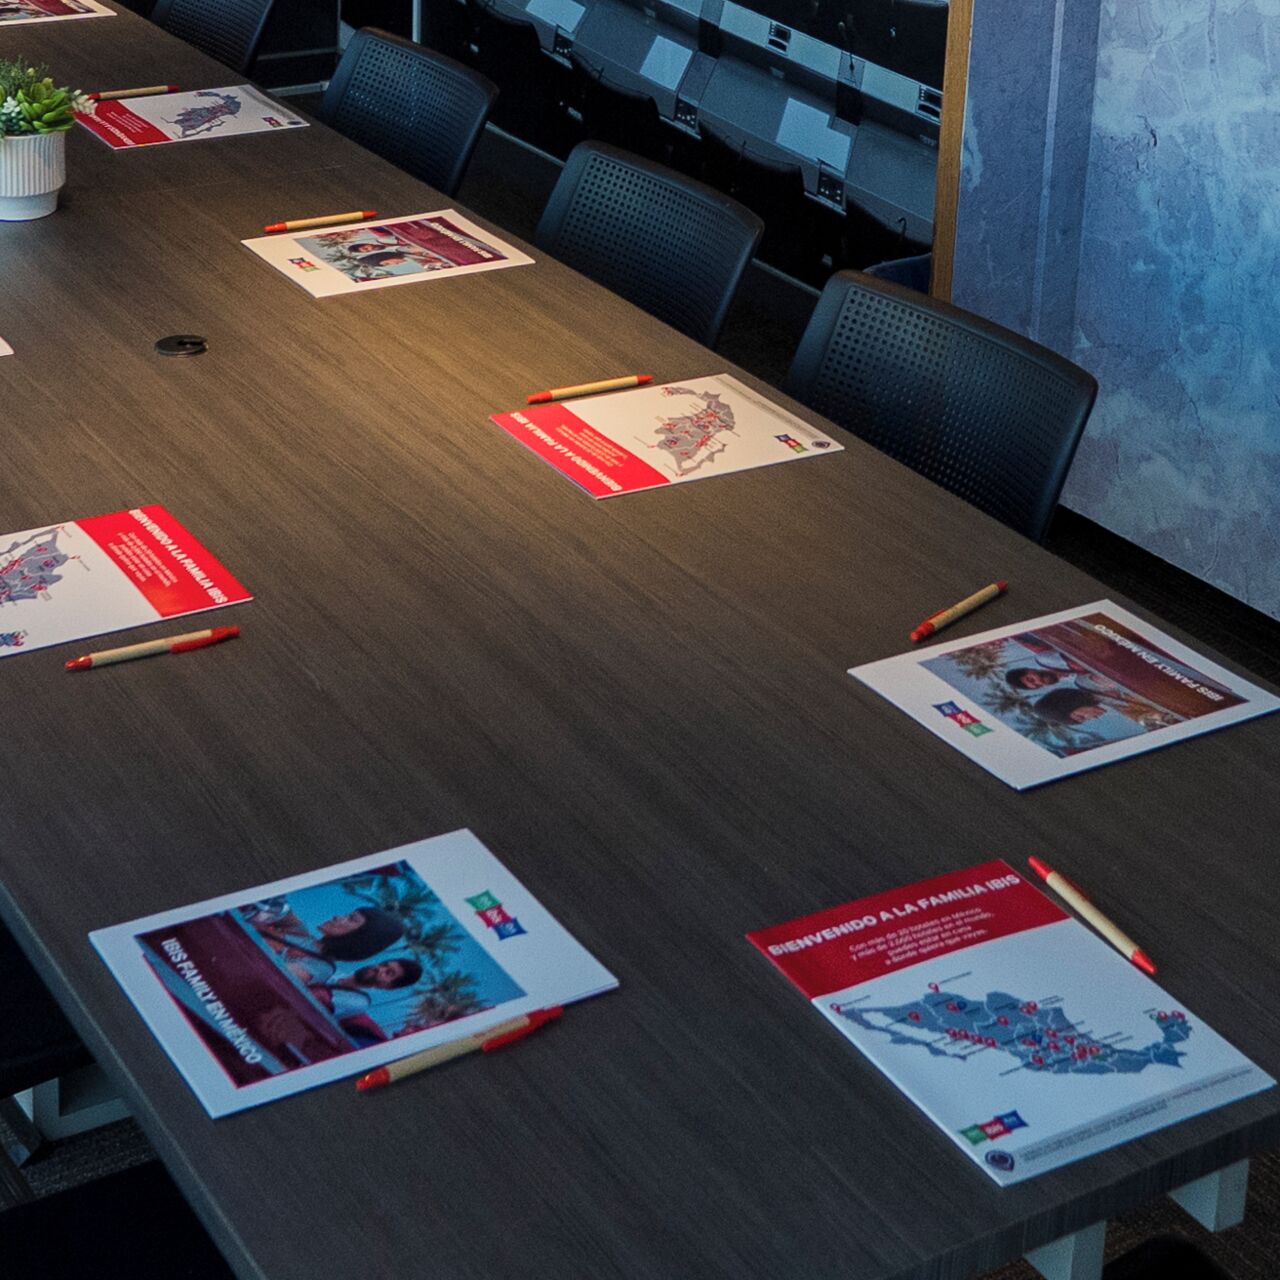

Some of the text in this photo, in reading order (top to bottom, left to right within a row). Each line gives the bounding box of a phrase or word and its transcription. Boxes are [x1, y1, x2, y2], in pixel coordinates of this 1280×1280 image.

[128, 509, 173, 545] BIENVENIDO
[170, 549, 188, 560] LA
[180, 558, 214, 589] FAMILIA
[206, 587, 228, 604] IBIS
[1155, 664, 1200, 689] FAMILY
[768, 874, 1020, 956] BIENVENIDO A LA FAMILIA IBIS
[161, 937, 188, 962] IBIS
[177, 960, 217, 1001] FAMILY
[205, 1000, 230, 1020] EN
